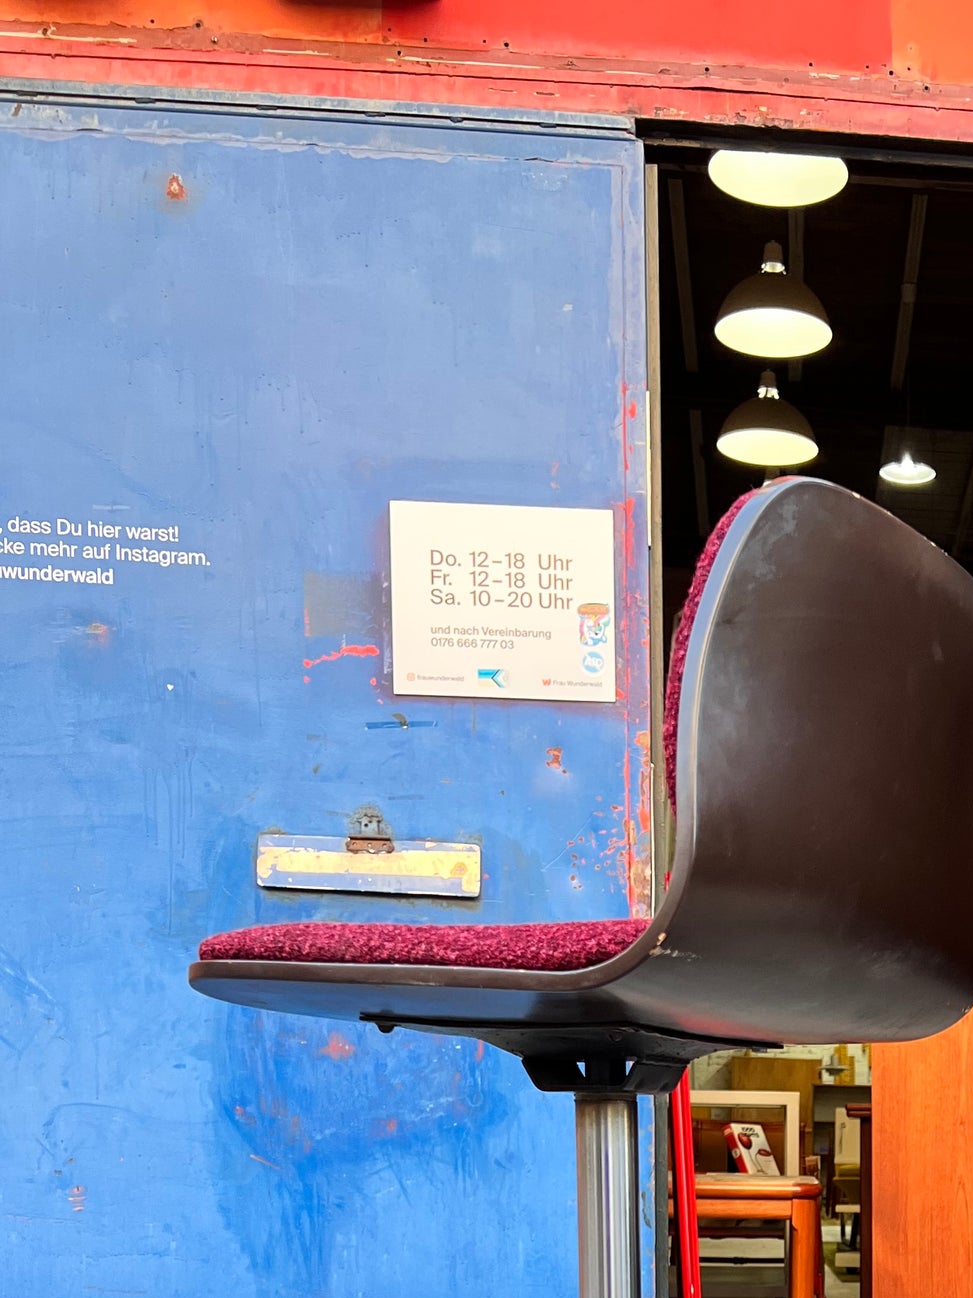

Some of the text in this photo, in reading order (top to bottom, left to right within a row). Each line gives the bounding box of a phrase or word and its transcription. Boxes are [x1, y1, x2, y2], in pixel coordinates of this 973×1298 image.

[7, 516, 179, 542] dass Du hier warst!
[30, 541, 77, 558] mehr
[82, 544, 110, 559] auf
[116, 544, 211, 566] Instagram.
[430, 549, 462, 567] Do.
[538, 554, 573, 571] Uhr
[430, 569, 453, 586] Fr.
[538, 573, 573, 590] Uhr
[430, 588, 462, 606] Sa.
[538, 593, 573, 610] Uhr
[430, 625, 552, 640] und nach Vereinbarung
[430, 637, 515, 649] 0176 666 777 03
